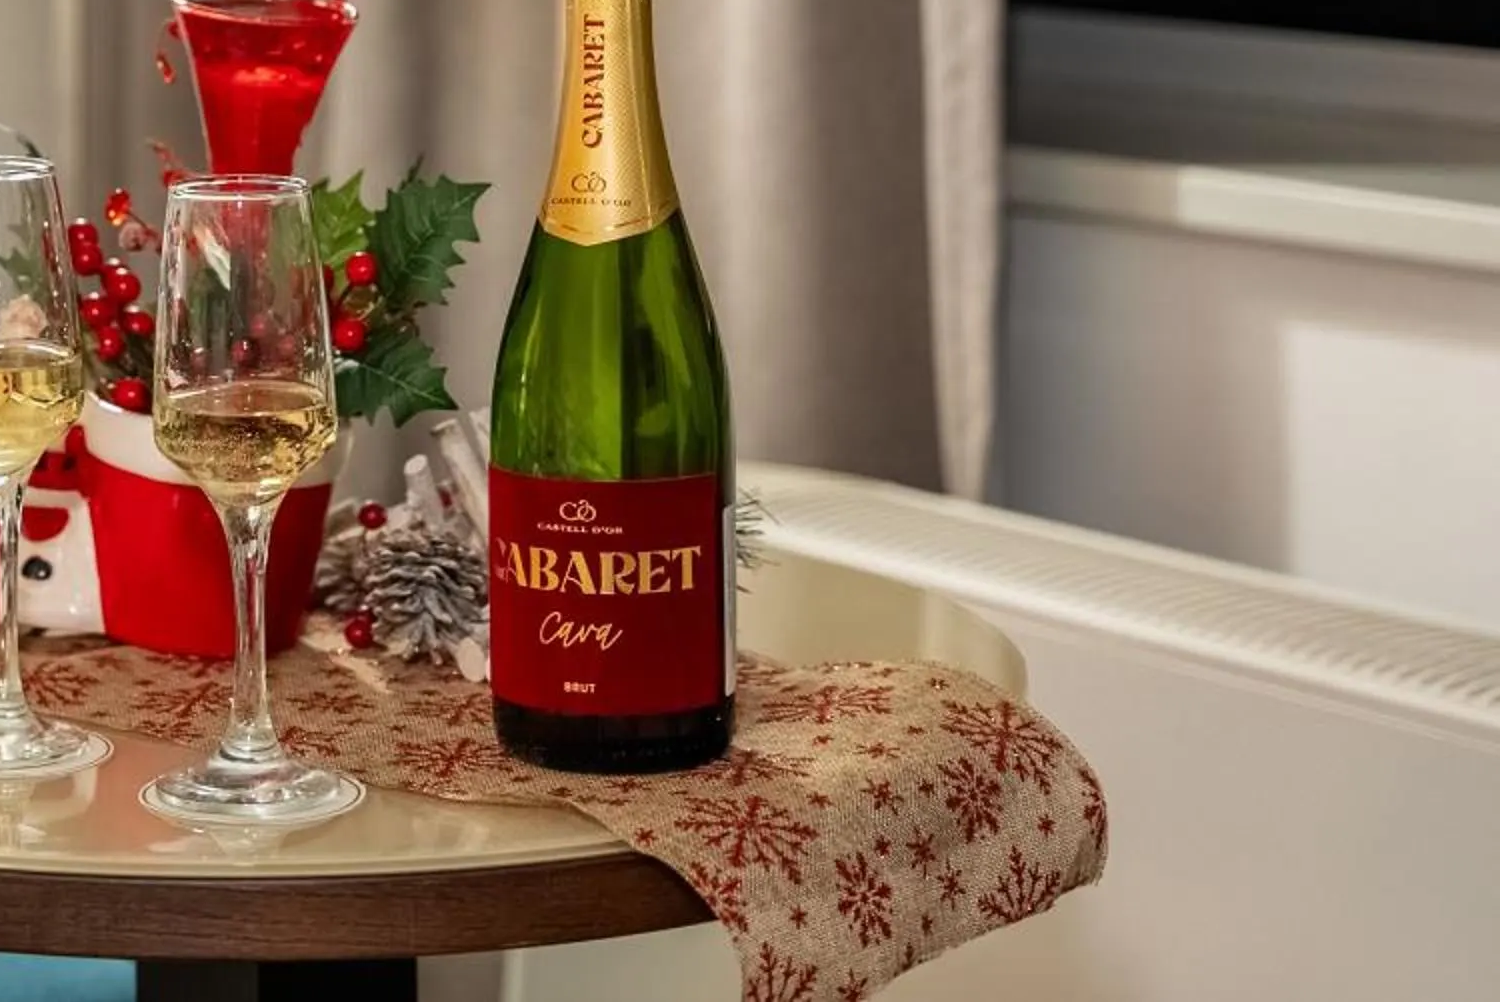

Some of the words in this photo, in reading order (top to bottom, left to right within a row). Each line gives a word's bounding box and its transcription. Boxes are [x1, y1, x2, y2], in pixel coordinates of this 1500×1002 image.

[582, 13, 605, 149] CABARET
[537, 522, 589, 534] CASTELL
[591, 525, 624, 535] D'OR
[539, 611, 623, 650] Cava
[563, 681, 597, 694] BRUT
